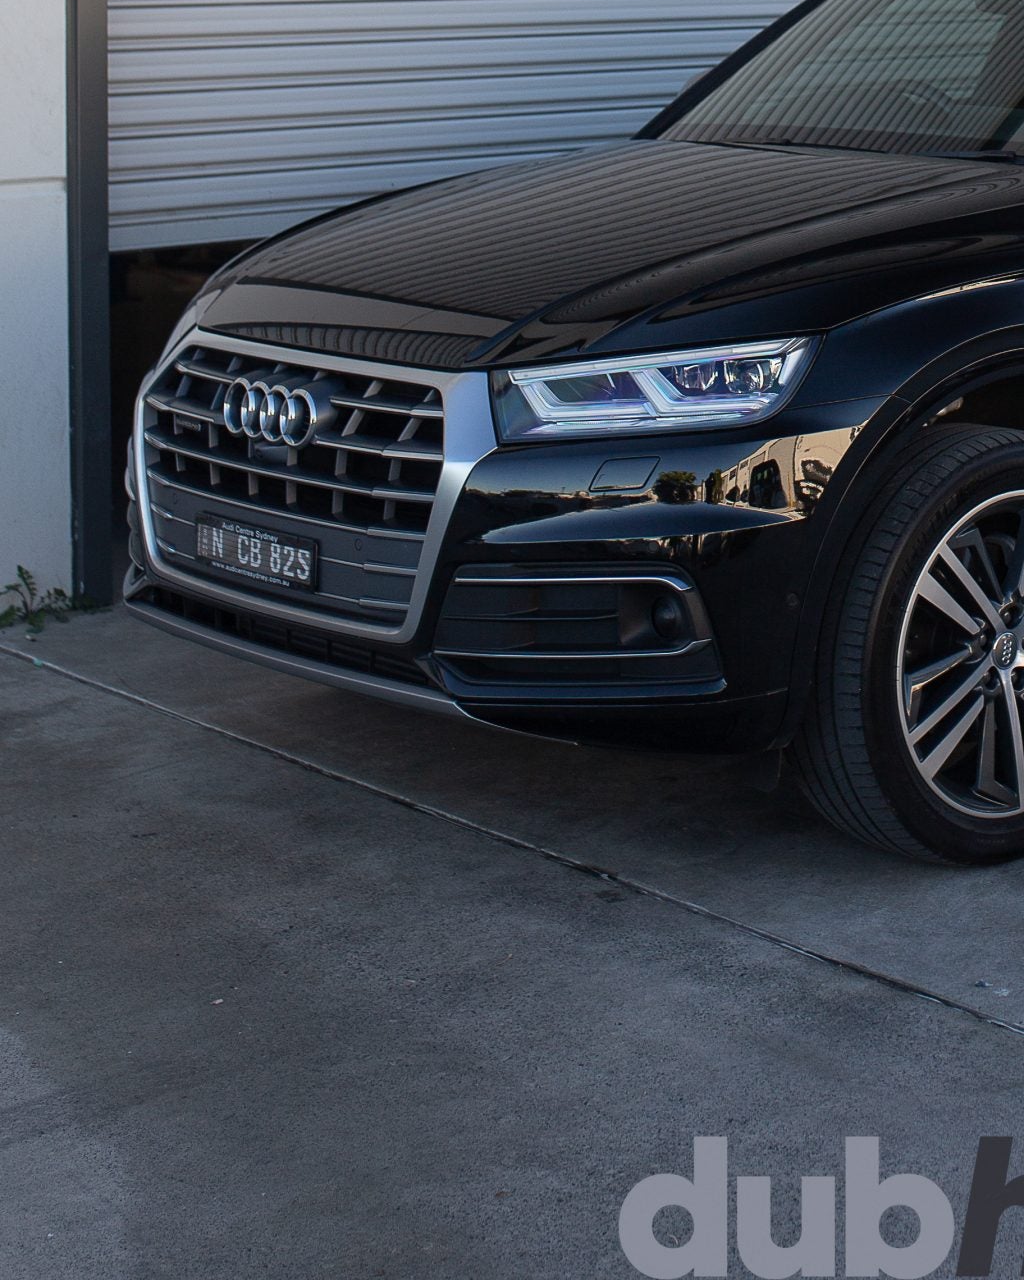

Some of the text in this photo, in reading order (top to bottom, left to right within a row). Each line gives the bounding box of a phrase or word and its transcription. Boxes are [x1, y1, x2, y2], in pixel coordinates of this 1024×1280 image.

[222, 521, 279, 543] Audi Centre Sydney
